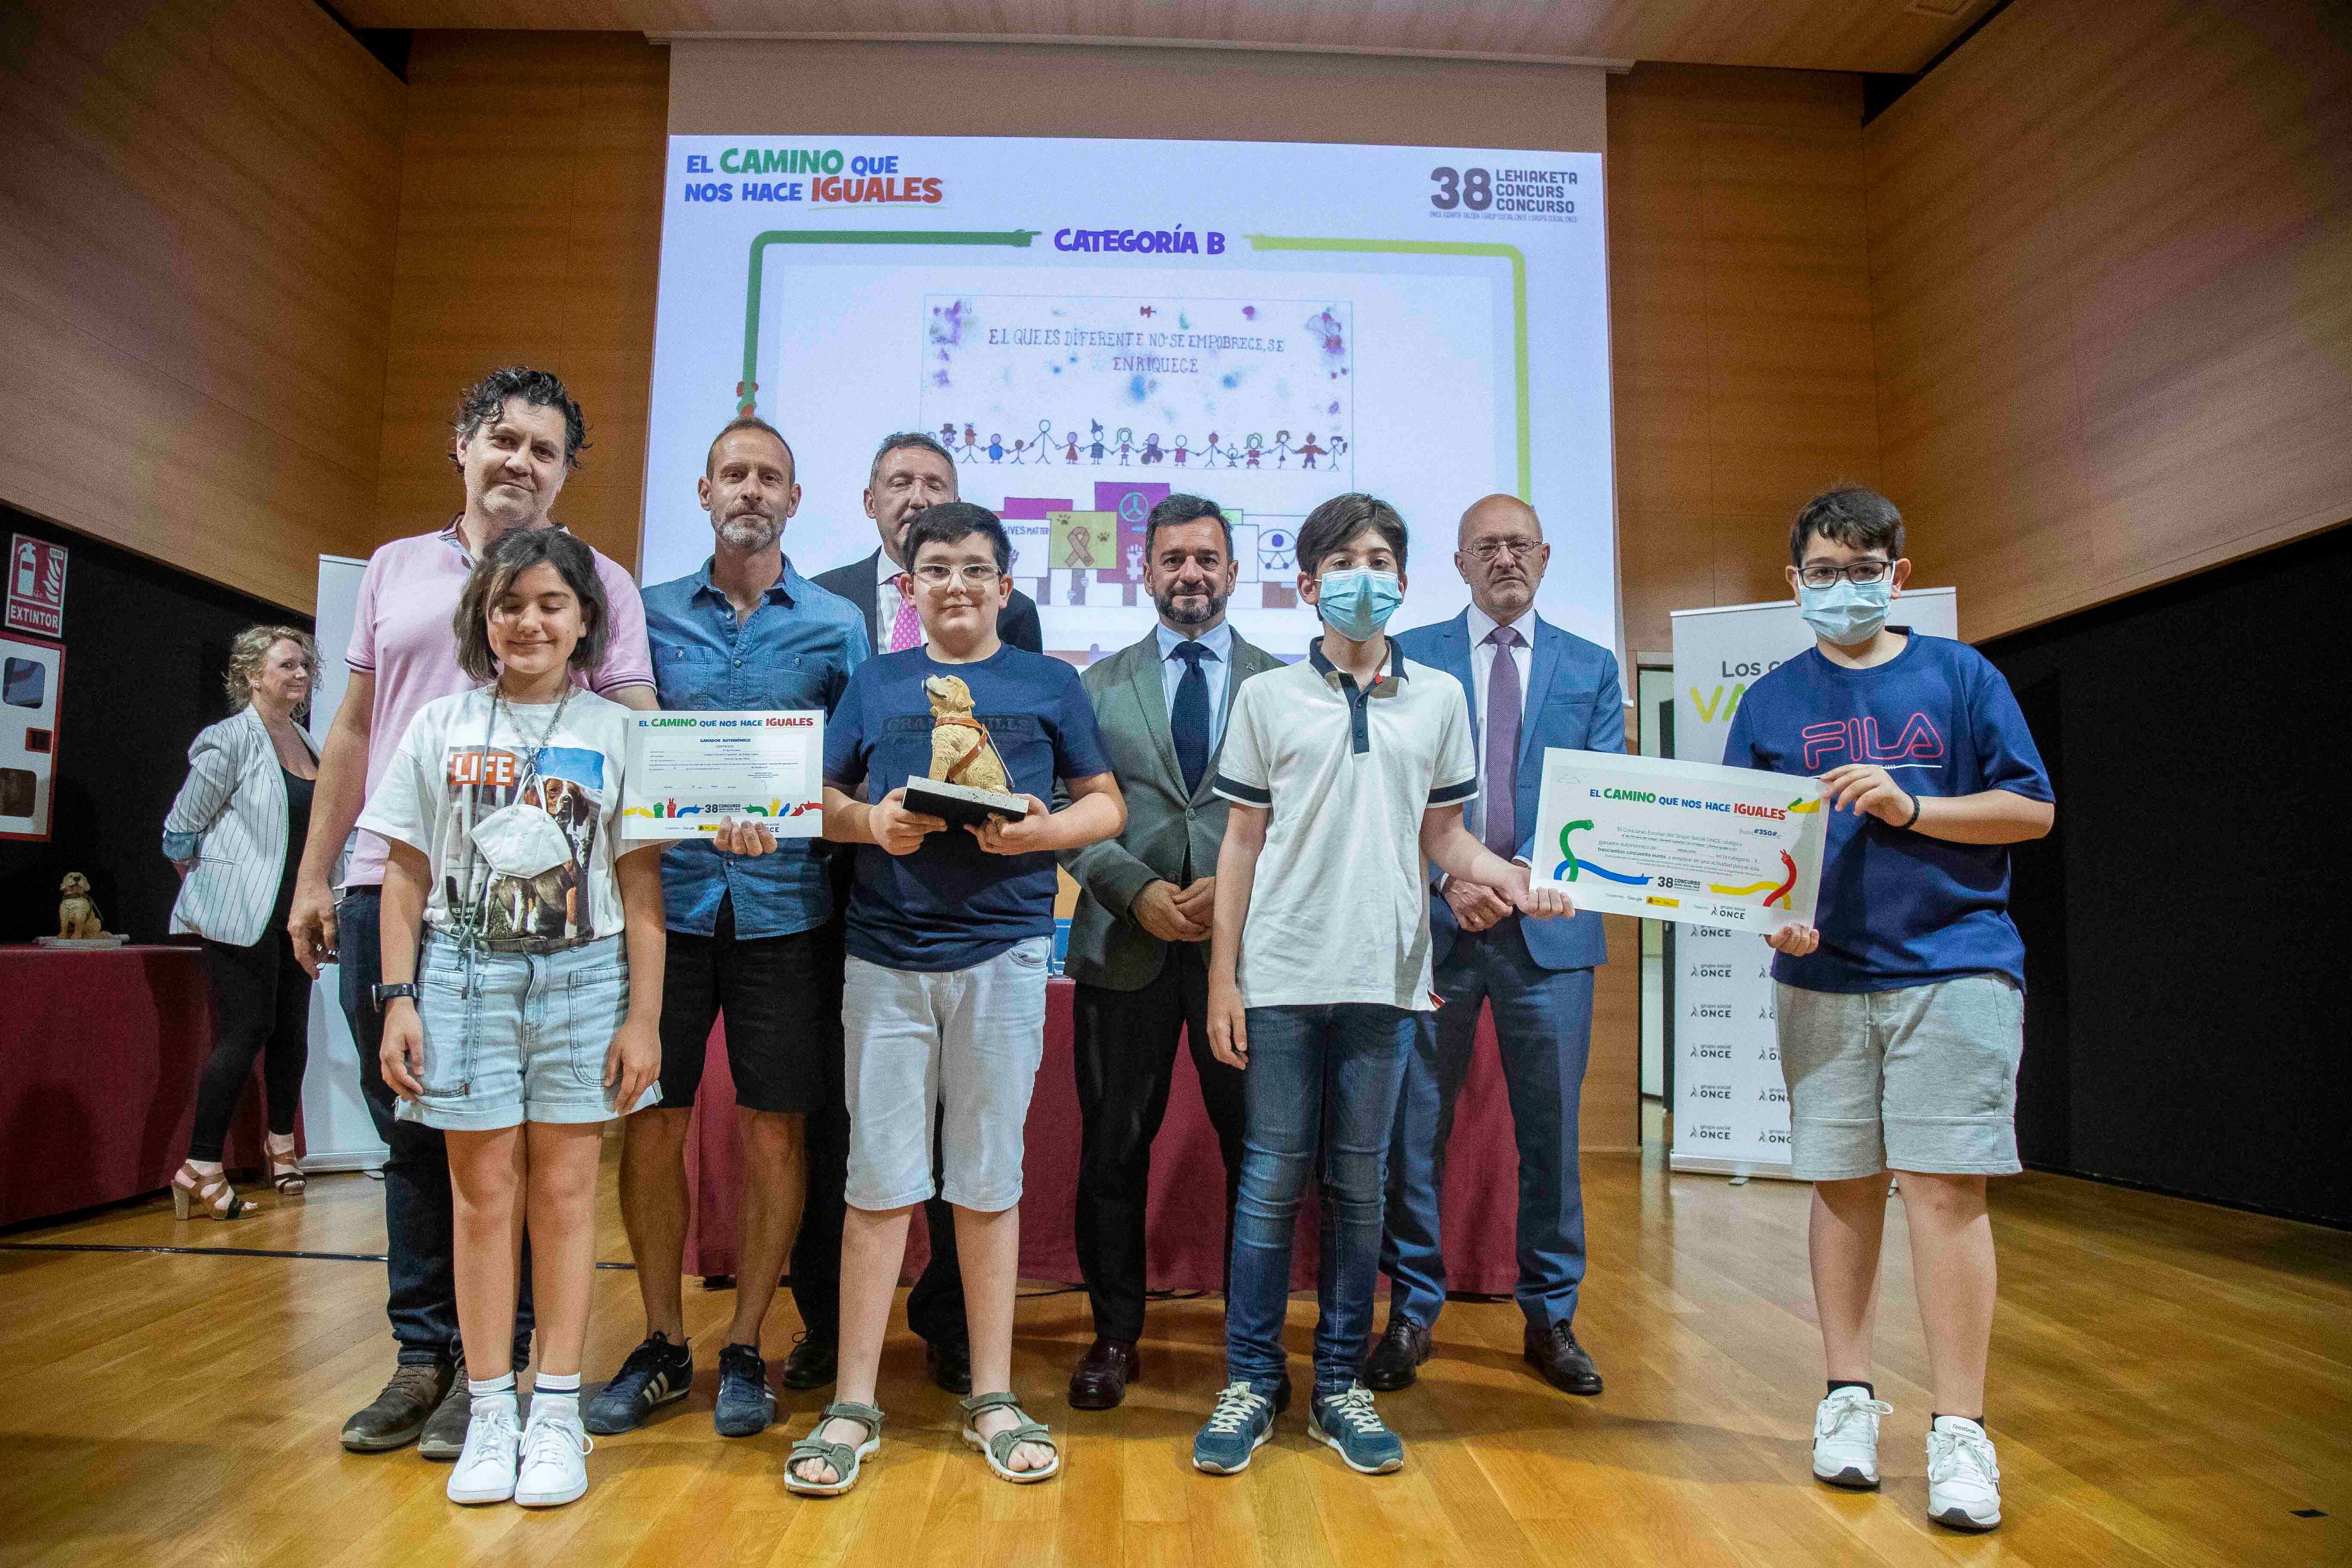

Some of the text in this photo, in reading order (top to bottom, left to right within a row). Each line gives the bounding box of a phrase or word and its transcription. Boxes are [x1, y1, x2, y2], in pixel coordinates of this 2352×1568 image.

[687, 148, 898, 176] EL CAMINO QUE
[1496, 169, 1578, 185] LEHIAKETA
[685, 176, 942, 203] NOS HACE IGUALES
[1430, 167, 1493, 211] 38
[1496, 184, 1565, 199] CONCURS
[1496, 199, 1575, 214] CONCURSO
[1055, 223, 1225, 255] CATEGORÍA B
[1013, 329, 1041, 345] QUE
[1044, 329, 1060, 345] ES
[1169, 334, 1186, 348] SE
[1268, 339, 1285, 352] SE
[1112, 356, 1199, 373] ENRIQUECE
[10, 605, 58, 629] EXTINTOR
[651, 718, 697, 727] CAMINO
[766, 718, 814, 726] IGUALES
[1802, 713, 1944, 770] FILA
[455, 756, 512, 783] LIFE
[705, 804, 718, 813] 38
[1589, 788, 1787, 821] EL CAMINO QUE NOS HACE IGUALES
[1658, 876, 1674, 888] 38
[1720, 910, 1745, 919] ONCE
[1700, 1090, 1731, 1099] ONCE
[1700, 1131, 1731, 1139] ONCE
[1769, 1135, 1791, 1144] ONC
[1832, 1394, 1854, 1403] Reebok
[1953, 1424, 1977, 1434] Reebok
